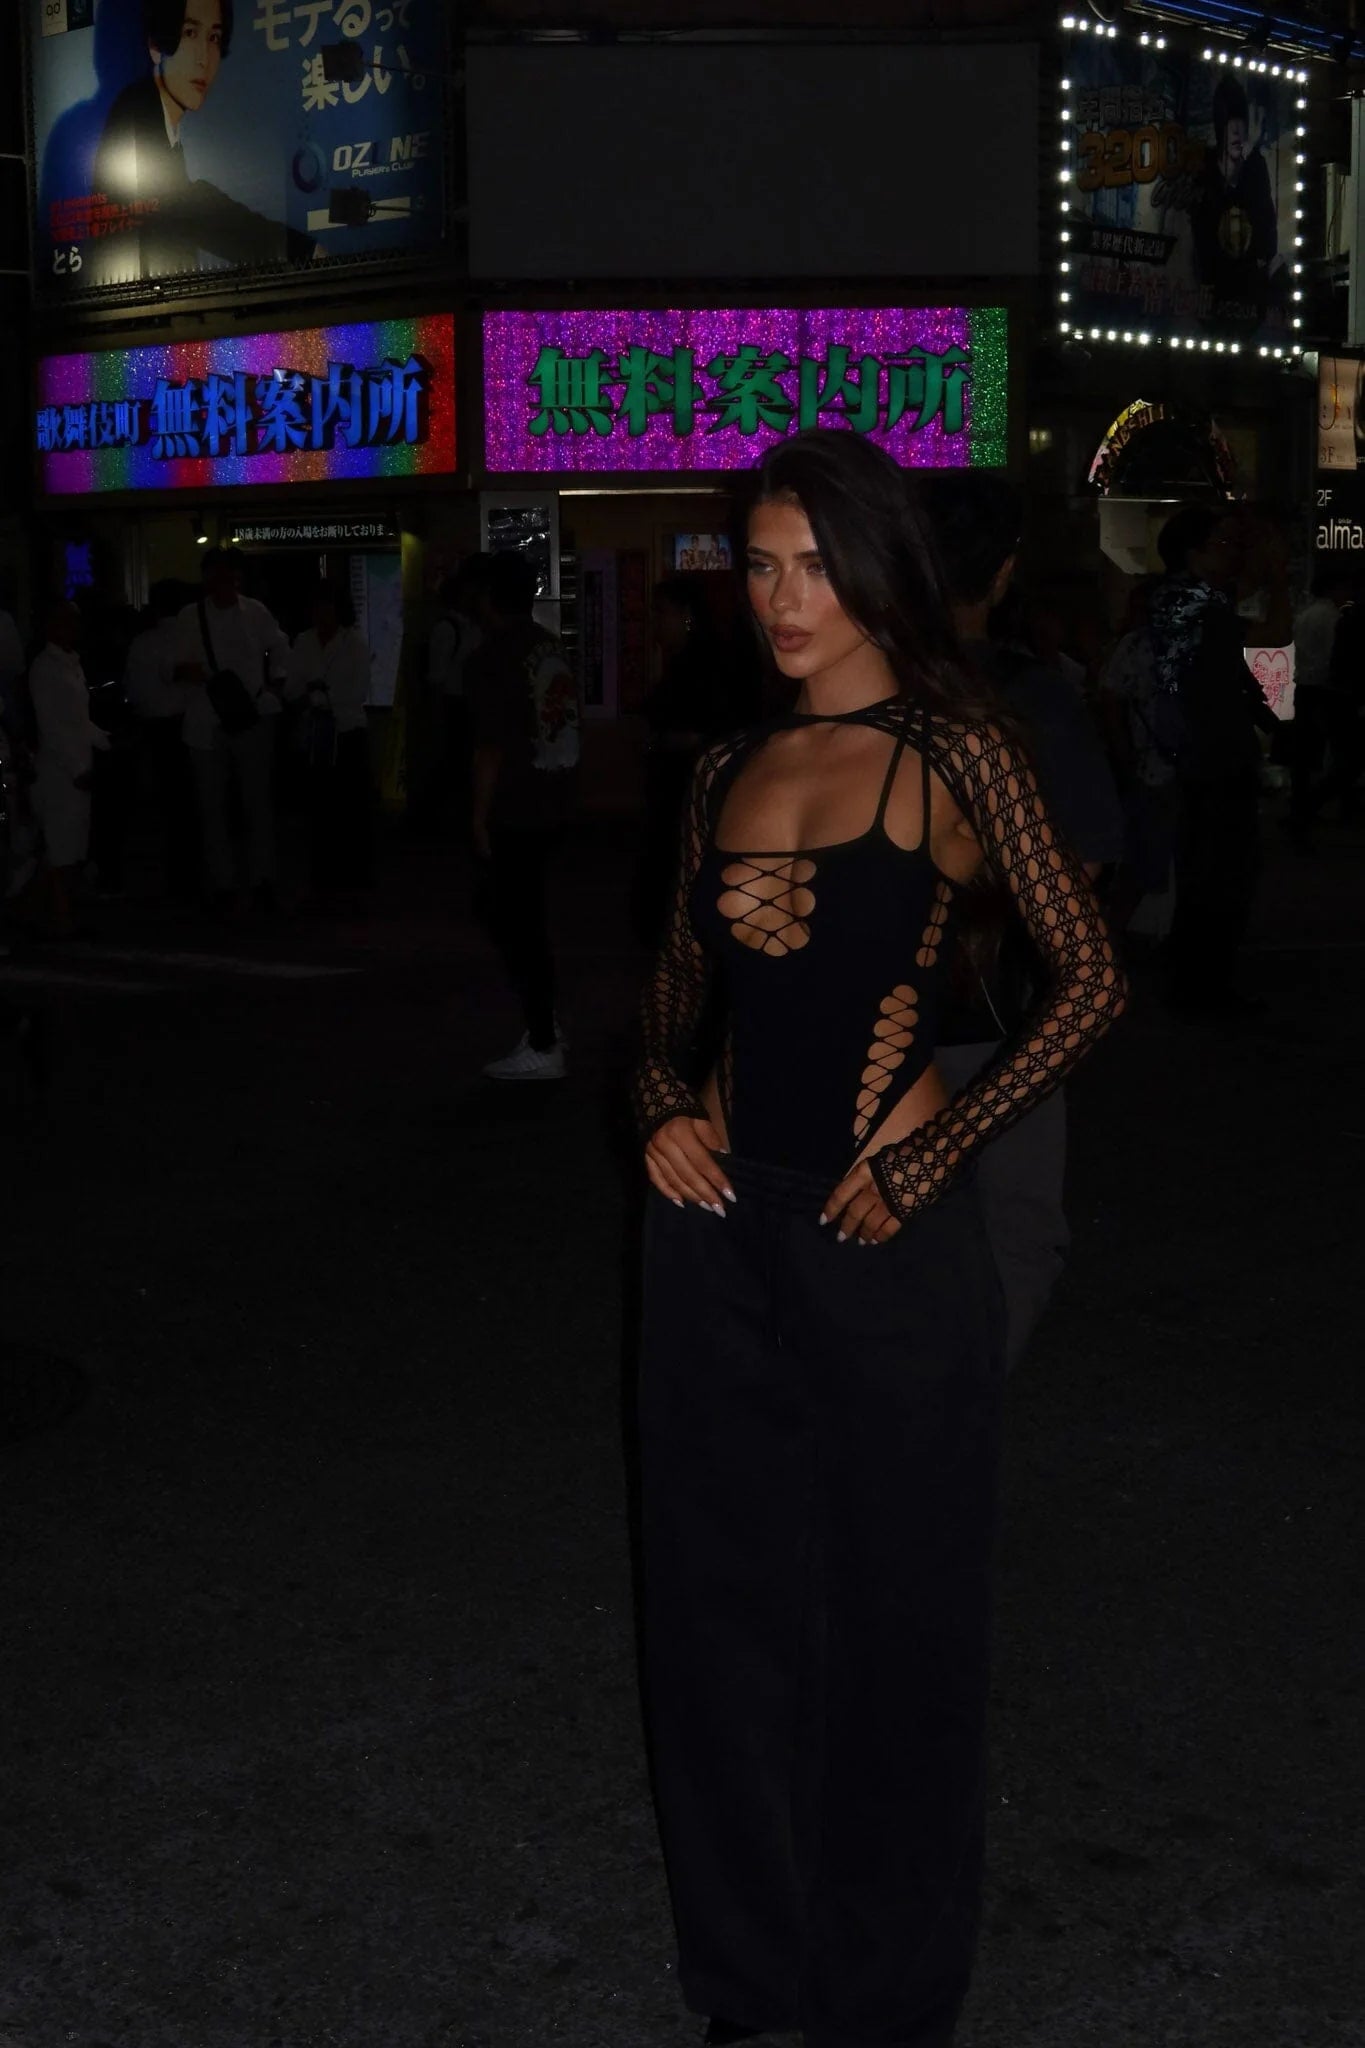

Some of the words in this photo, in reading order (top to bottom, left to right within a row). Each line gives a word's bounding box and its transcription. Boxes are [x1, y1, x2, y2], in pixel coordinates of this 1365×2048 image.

[253, 0, 414, 52] モテるって
[52, 246, 83, 275] とら
[35, 401, 141, 451] 歌舞伎町
[151, 356, 429, 459] 無料案内所
[527, 343, 973, 437] 無料案内所
[1316, 489, 1333, 507] 2F
[1316, 518, 1364, 550] alma
